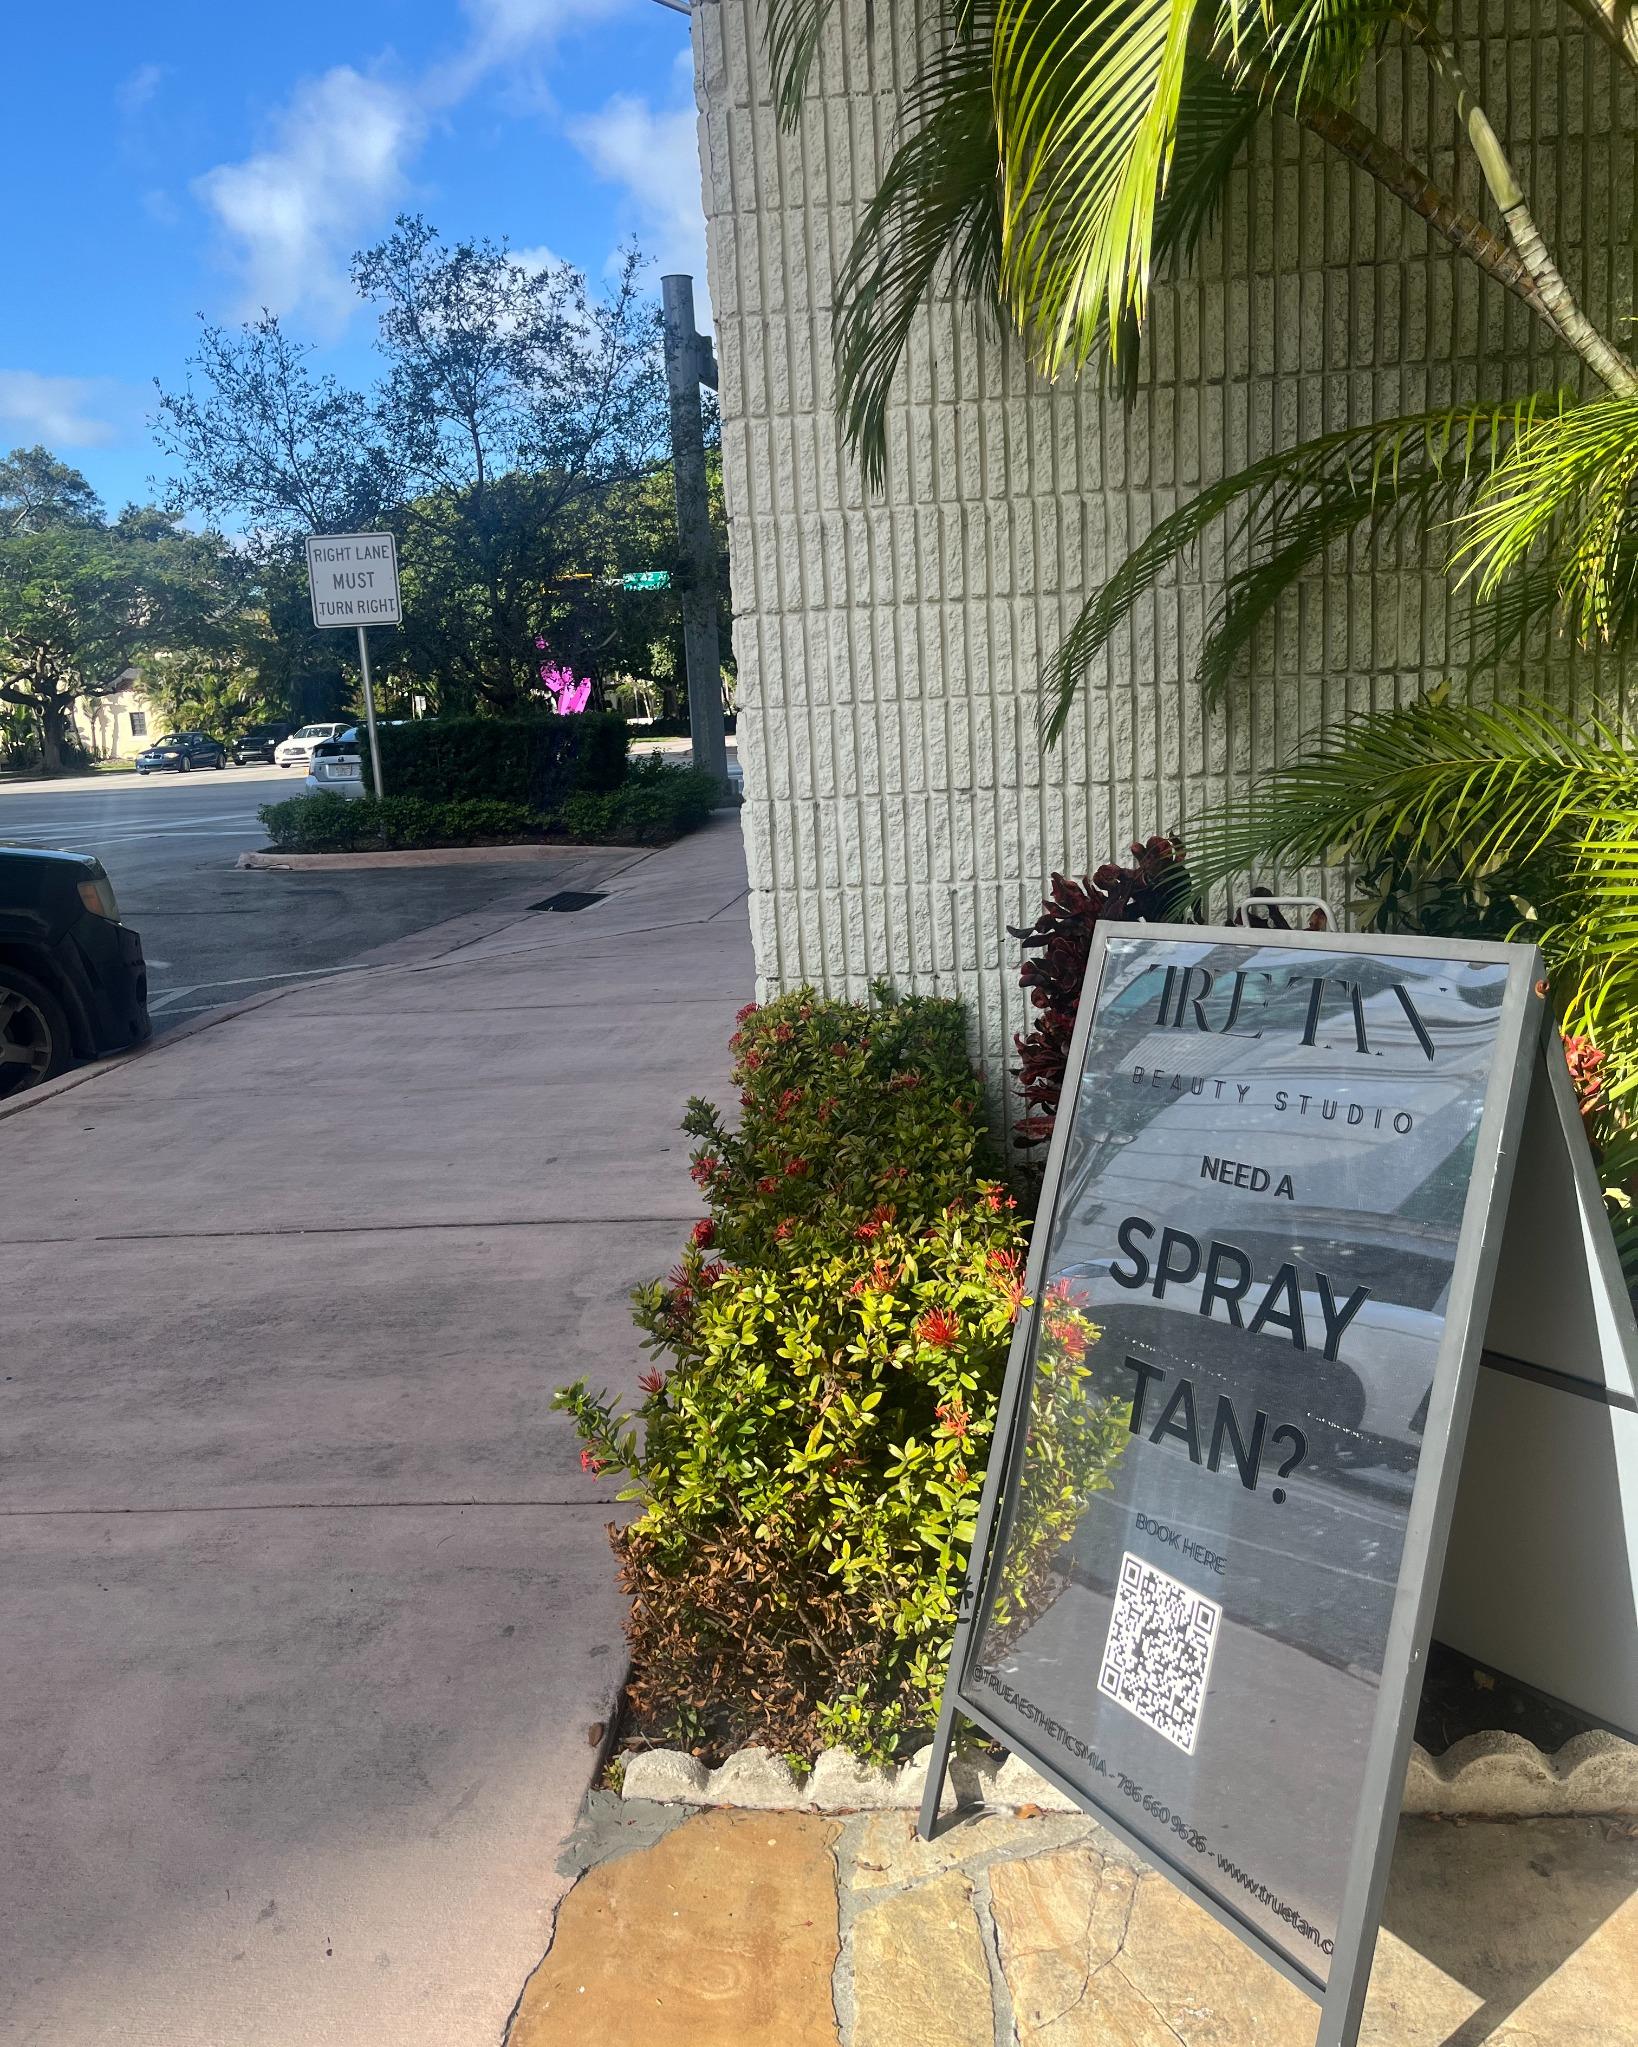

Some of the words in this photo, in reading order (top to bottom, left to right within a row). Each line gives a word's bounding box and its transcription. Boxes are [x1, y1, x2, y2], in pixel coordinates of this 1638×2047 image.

[313, 546, 351, 562] RIGHT
[356, 545, 390, 560] LANE
[333, 571, 374, 589] MUST
[319, 601, 354, 615] TURN
[358, 598, 395, 614] RIGHT
[1132, 1066, 1251, 1103] BEAUTY
[1274, 1091, 1413, 1134] STUDIO
[1200, 1155, 1271, 1192] NEED
[1273, 1174, 1295, 1201] A
[1109, 1216, 1372, 1363] SPRAY
[1124, 1355, 1309, 1504] TAN?
[1135, 1512, 1182, 1550] BOOK
[1182, 1537, 1227, 1576] HERE
[973, 1664, 1107, 1777] @TRUEAESTHETICSMIA
[1117, 1772, 1143, 1803] 786
[1142, 1794, 1170, 1824] 660
[1170, 1815, 1207, 1853] 9626
